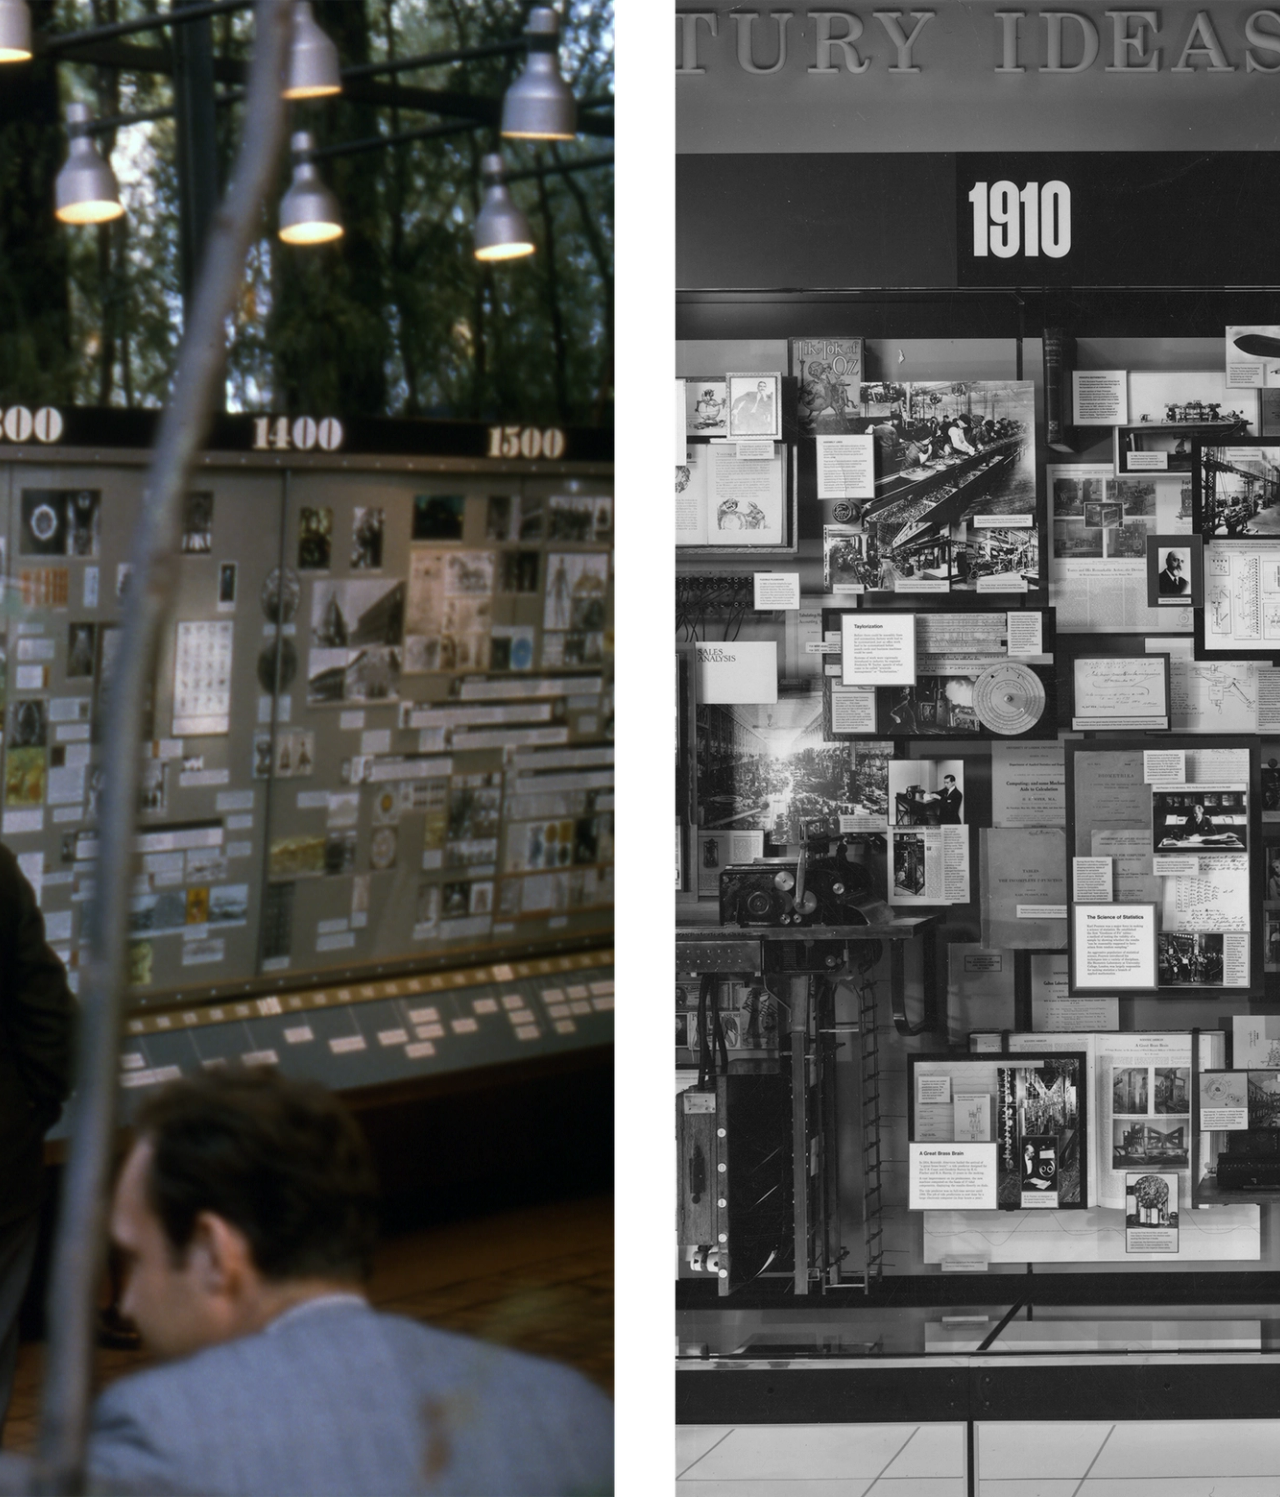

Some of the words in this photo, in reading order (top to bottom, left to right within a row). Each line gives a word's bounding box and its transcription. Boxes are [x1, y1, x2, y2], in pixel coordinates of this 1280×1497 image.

[671, 10, 936, 75] TURY
[969, 180, 1072, 259] 1910
[832, 355, 860, 376] Oz
[253, 416, 343, 451] 1400
[488, 426, 565, 459] 1500
[697, 648, 723, 656] SALES
